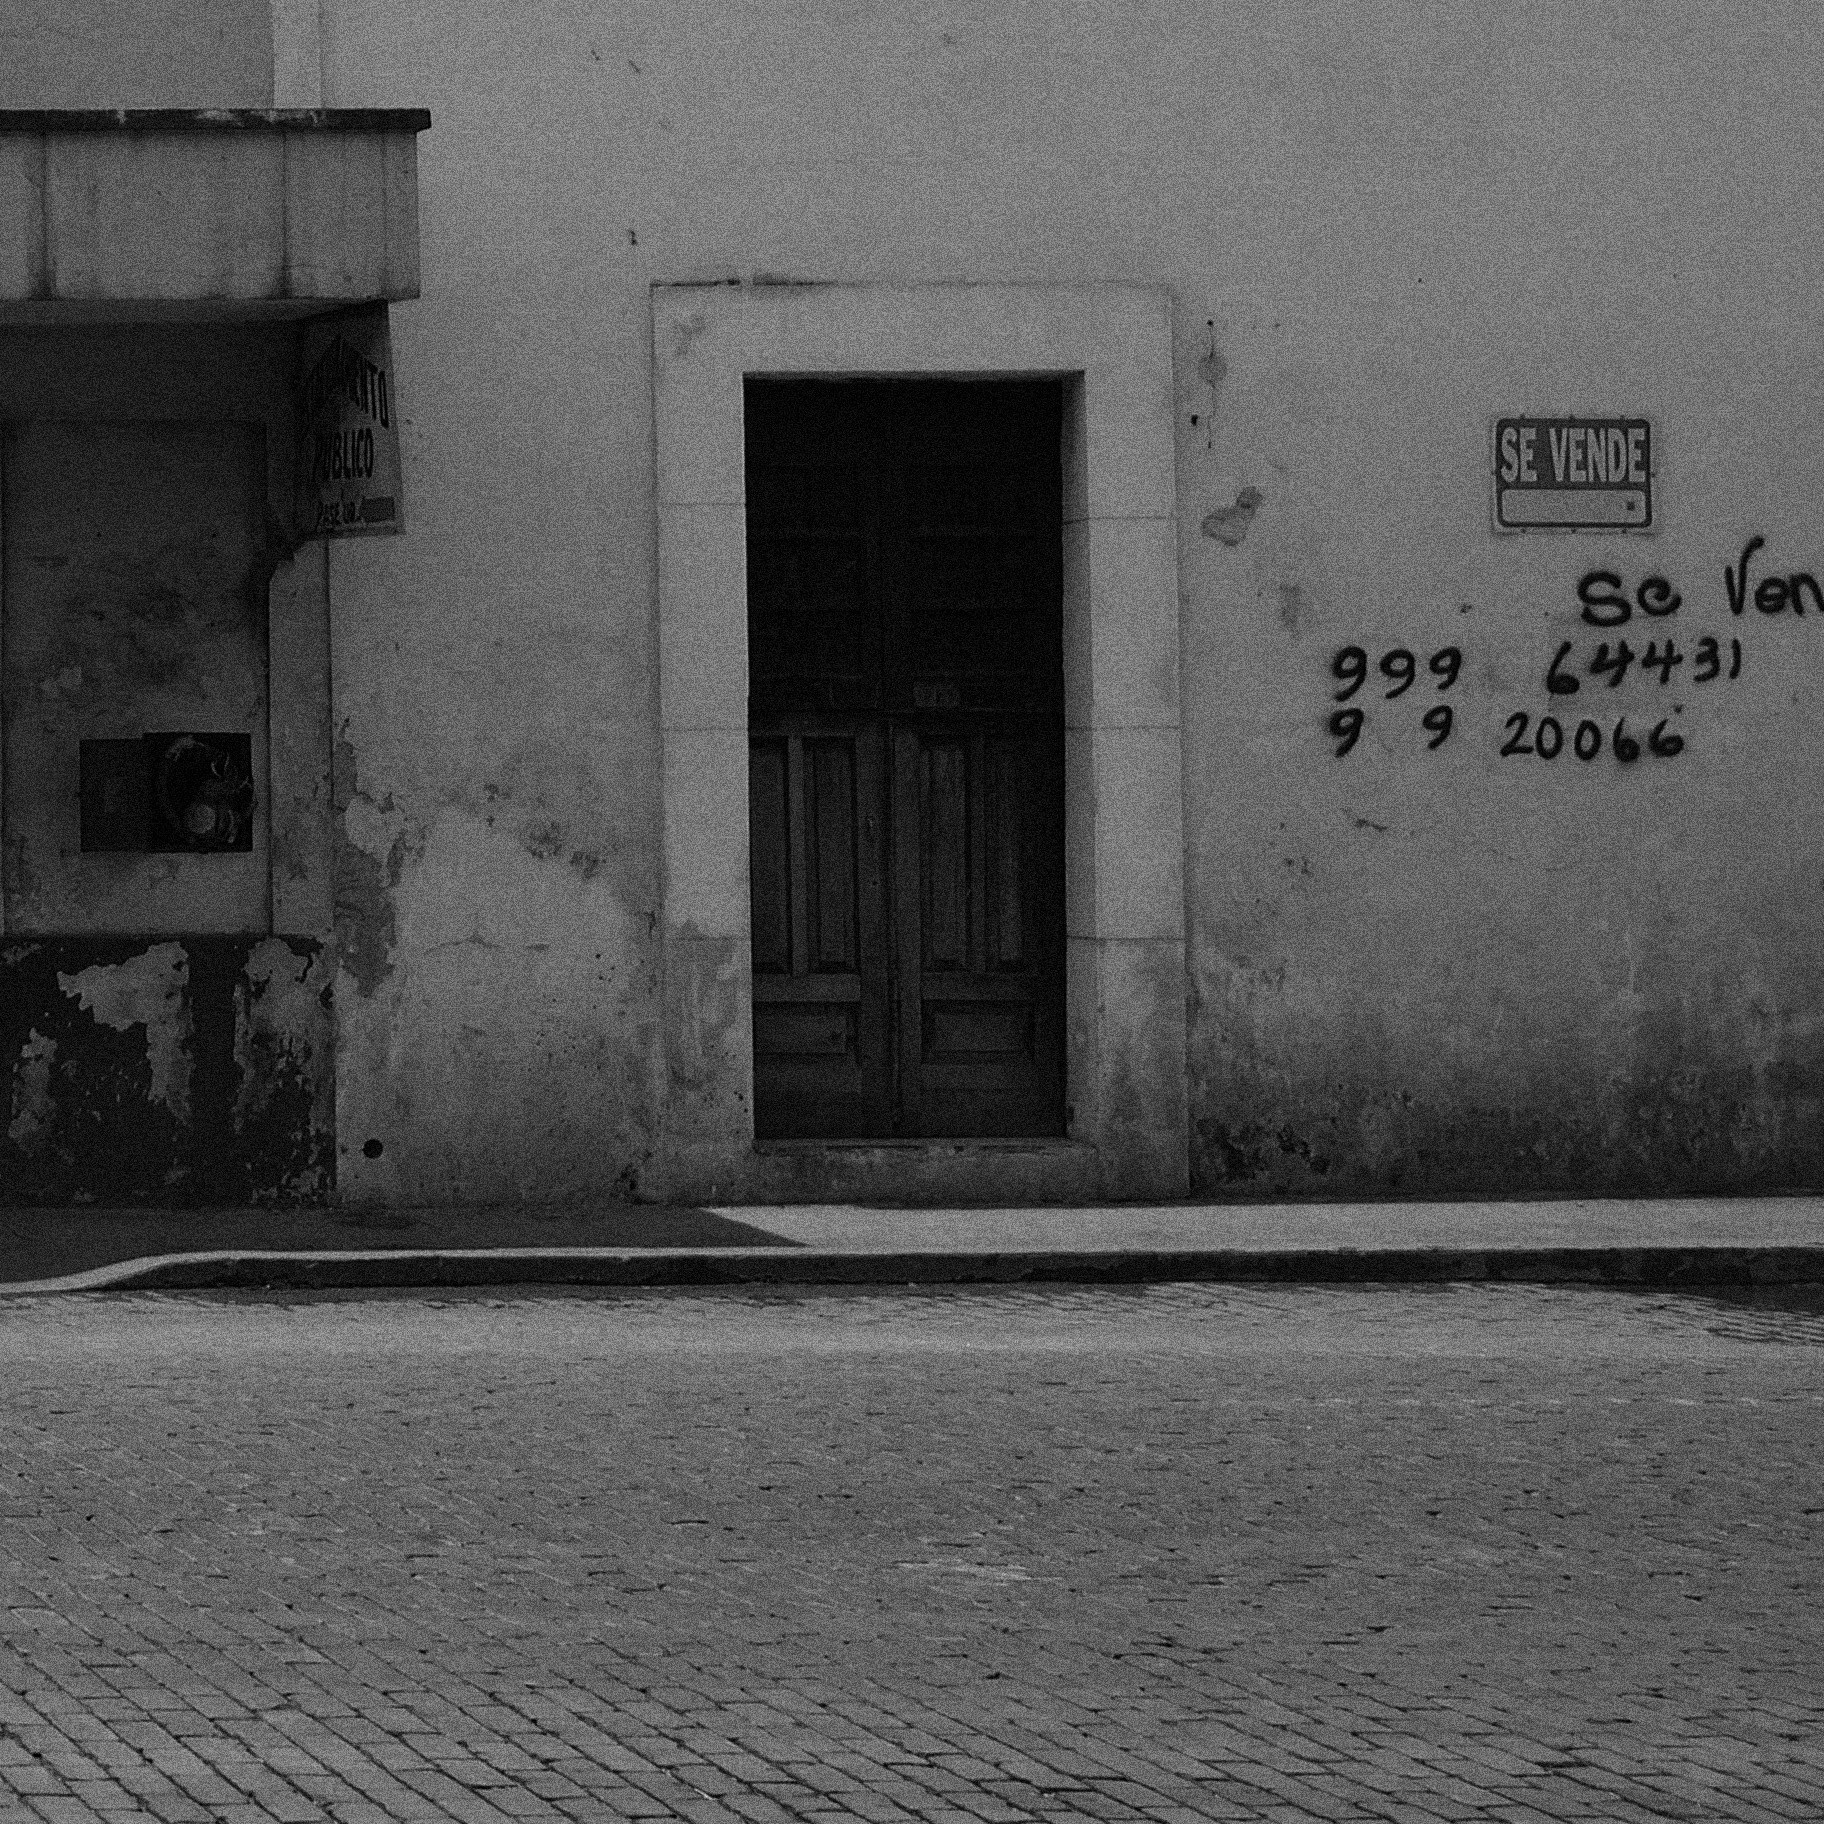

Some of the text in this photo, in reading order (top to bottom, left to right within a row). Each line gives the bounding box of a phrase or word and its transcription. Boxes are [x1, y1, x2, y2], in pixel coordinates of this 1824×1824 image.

[1499, 426, 1646, 483] SE VENDE
[1576, 571, 1682, 627] Se
[1331, 645, 1462, 702] 999
[1500, 712, 1685, 764] 20066
